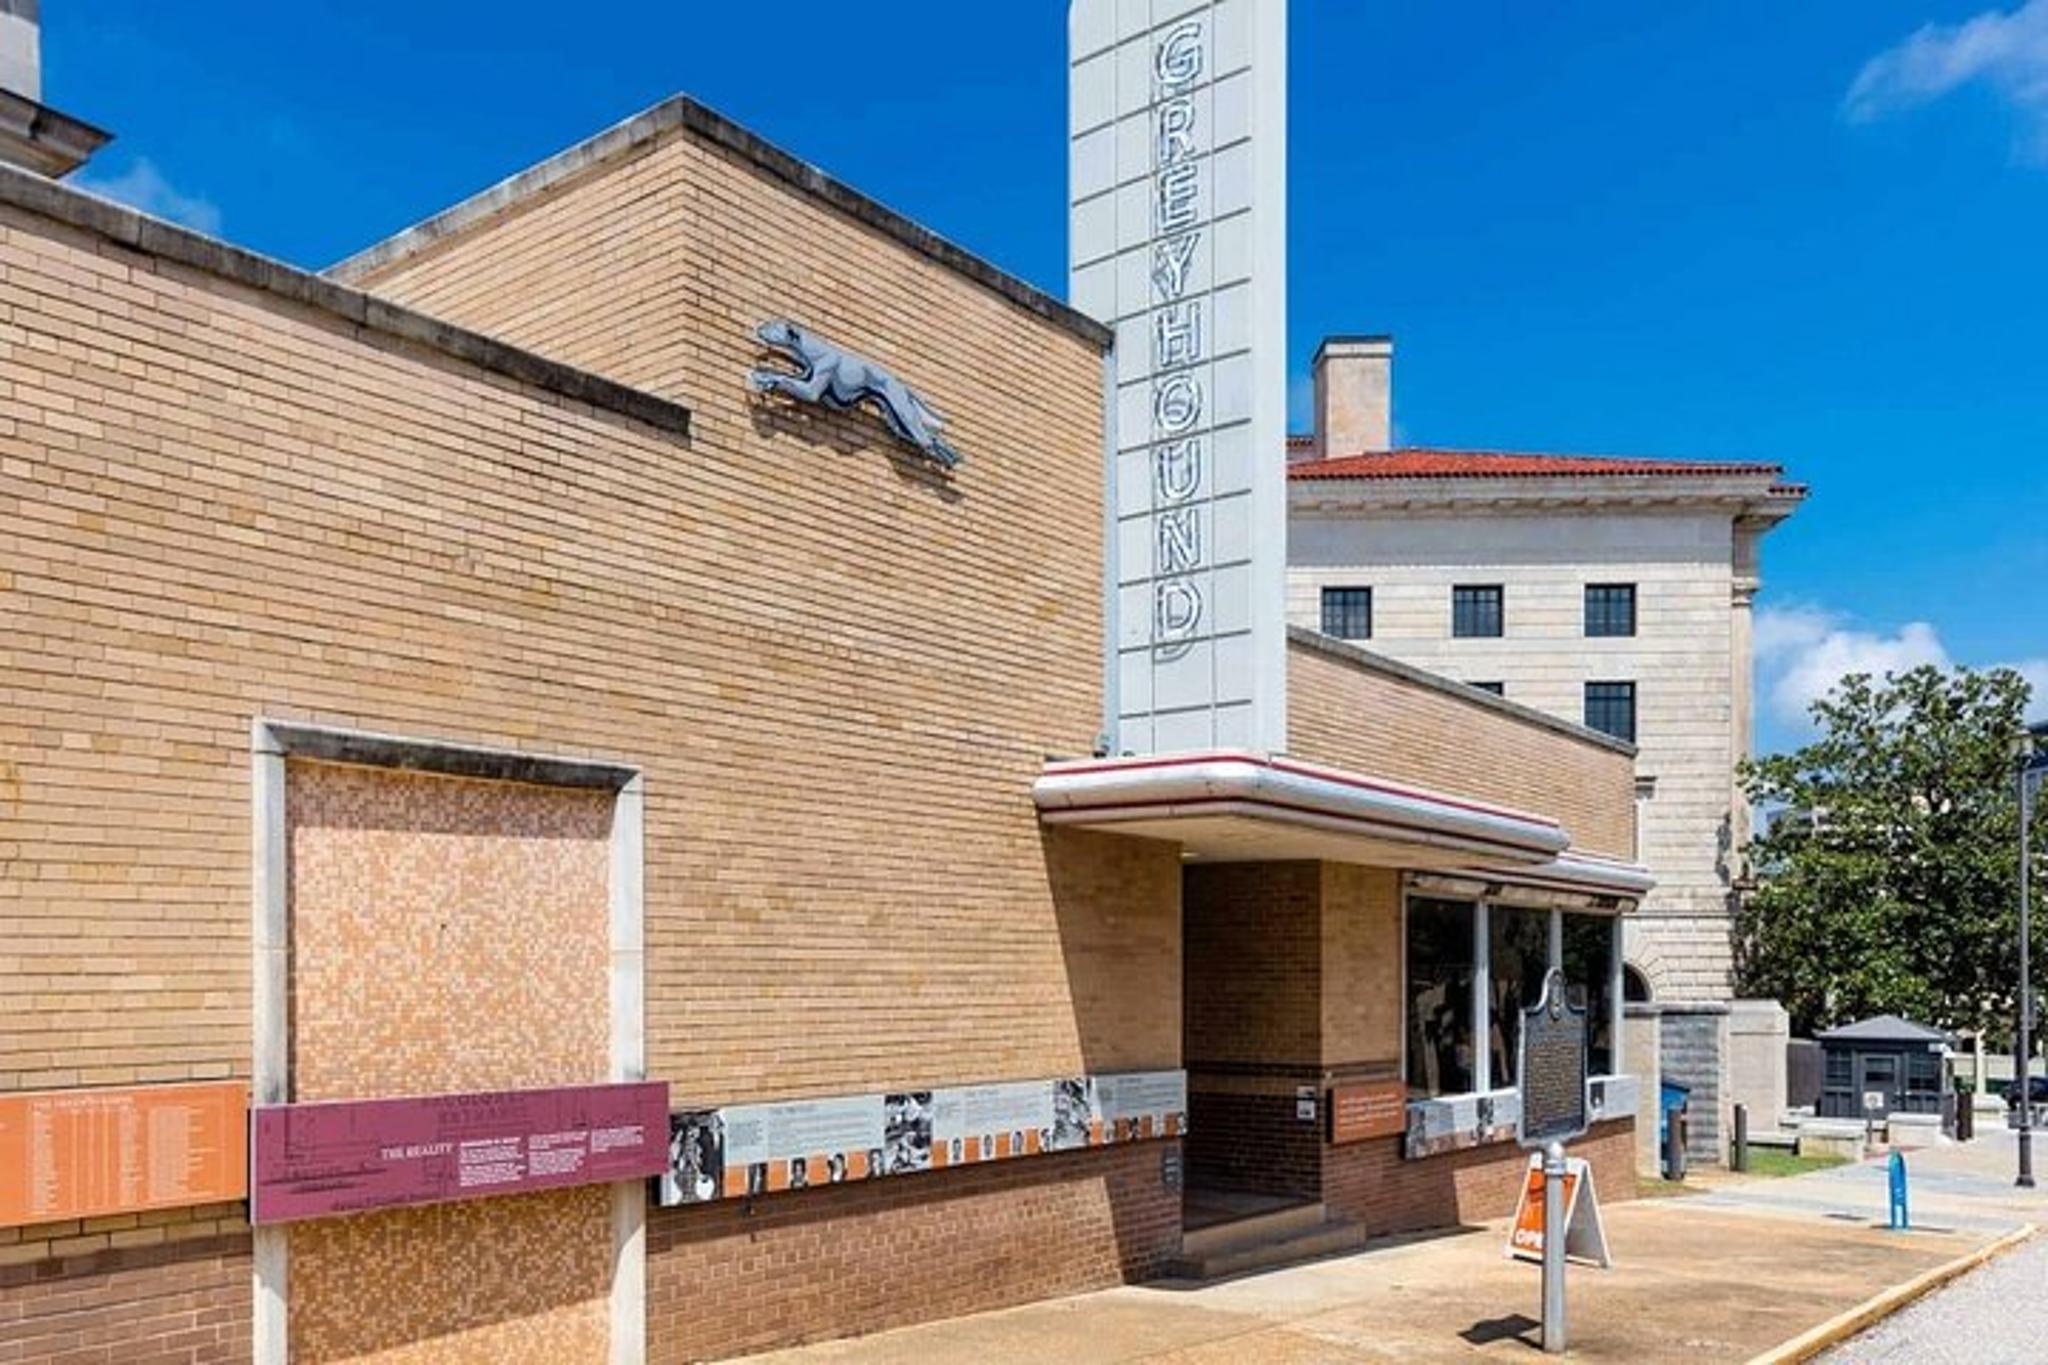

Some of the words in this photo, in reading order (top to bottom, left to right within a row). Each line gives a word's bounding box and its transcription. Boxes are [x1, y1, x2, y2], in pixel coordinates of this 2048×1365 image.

[1157, 22, 1202, 638] GREYHOUND
[381, 1146, 404, 1160] THE
[406, 1142, 453, 1158] REALITY
[1515, 1228, 1543, 1248] OPE
